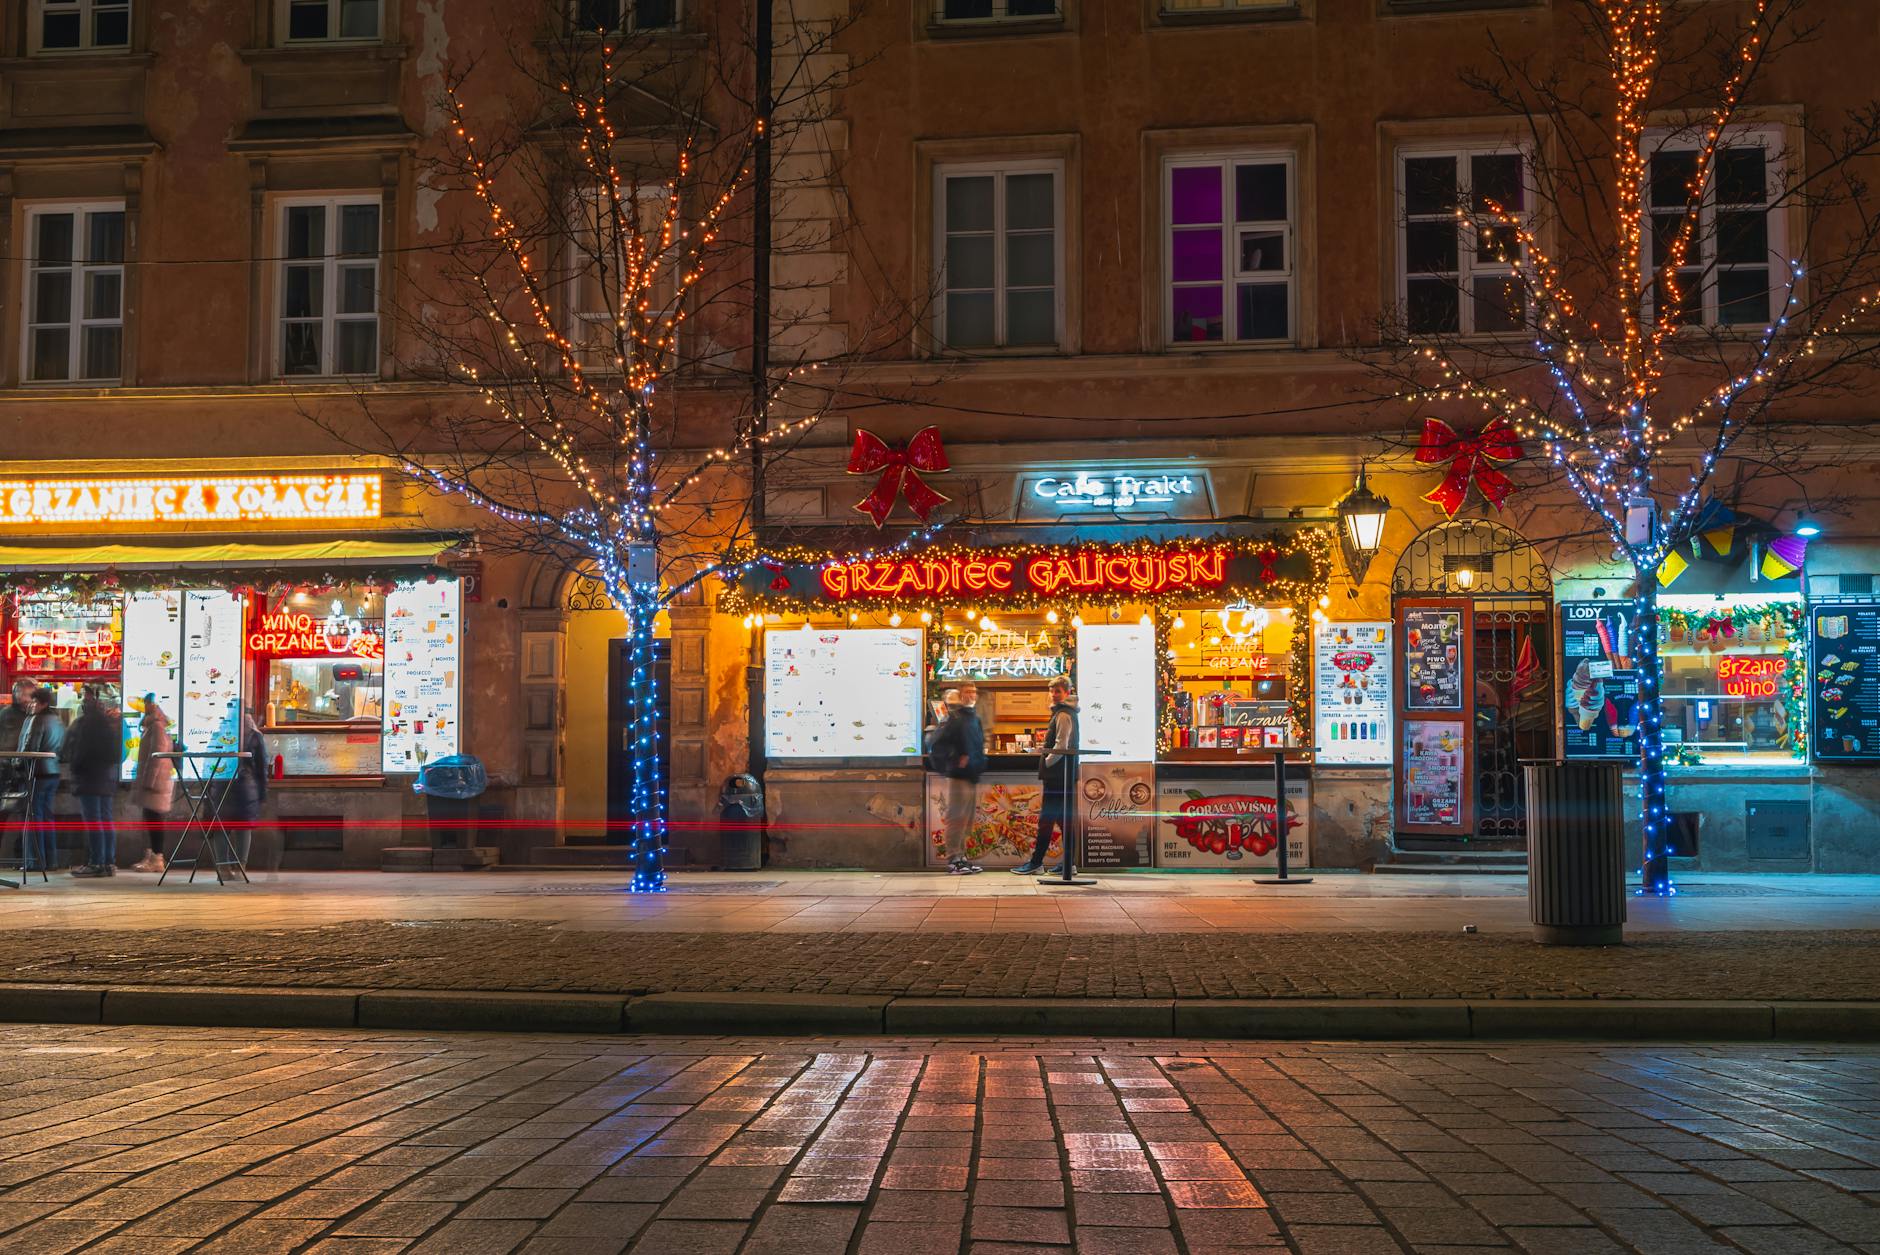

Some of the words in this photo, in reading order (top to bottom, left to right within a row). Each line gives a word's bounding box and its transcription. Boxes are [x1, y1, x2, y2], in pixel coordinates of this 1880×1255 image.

[1113, 475, 1193, 496] Trakt
[822, 558, 1012, 598] GRZANIEC
[1028, 551, 1225, 592] GALICYJSKI
[262, 614, 311, 631] WINO
[1569, 607, 1602, 618] LODY
[7, 629, 115, 659] KEBAB
[249, 633, 325, 651] GRZANE
[950, 629, 1051, 650] TORTILLA
[937, 655, 1065, 676] ZAPIEKANKI
[1209, 657, 1268, 670] GRZANE
[1719, 658, 1787, 678] grzane
[1727, 678, 1776, 697] wino
[1089, 799, 1137, 821] Coffee
